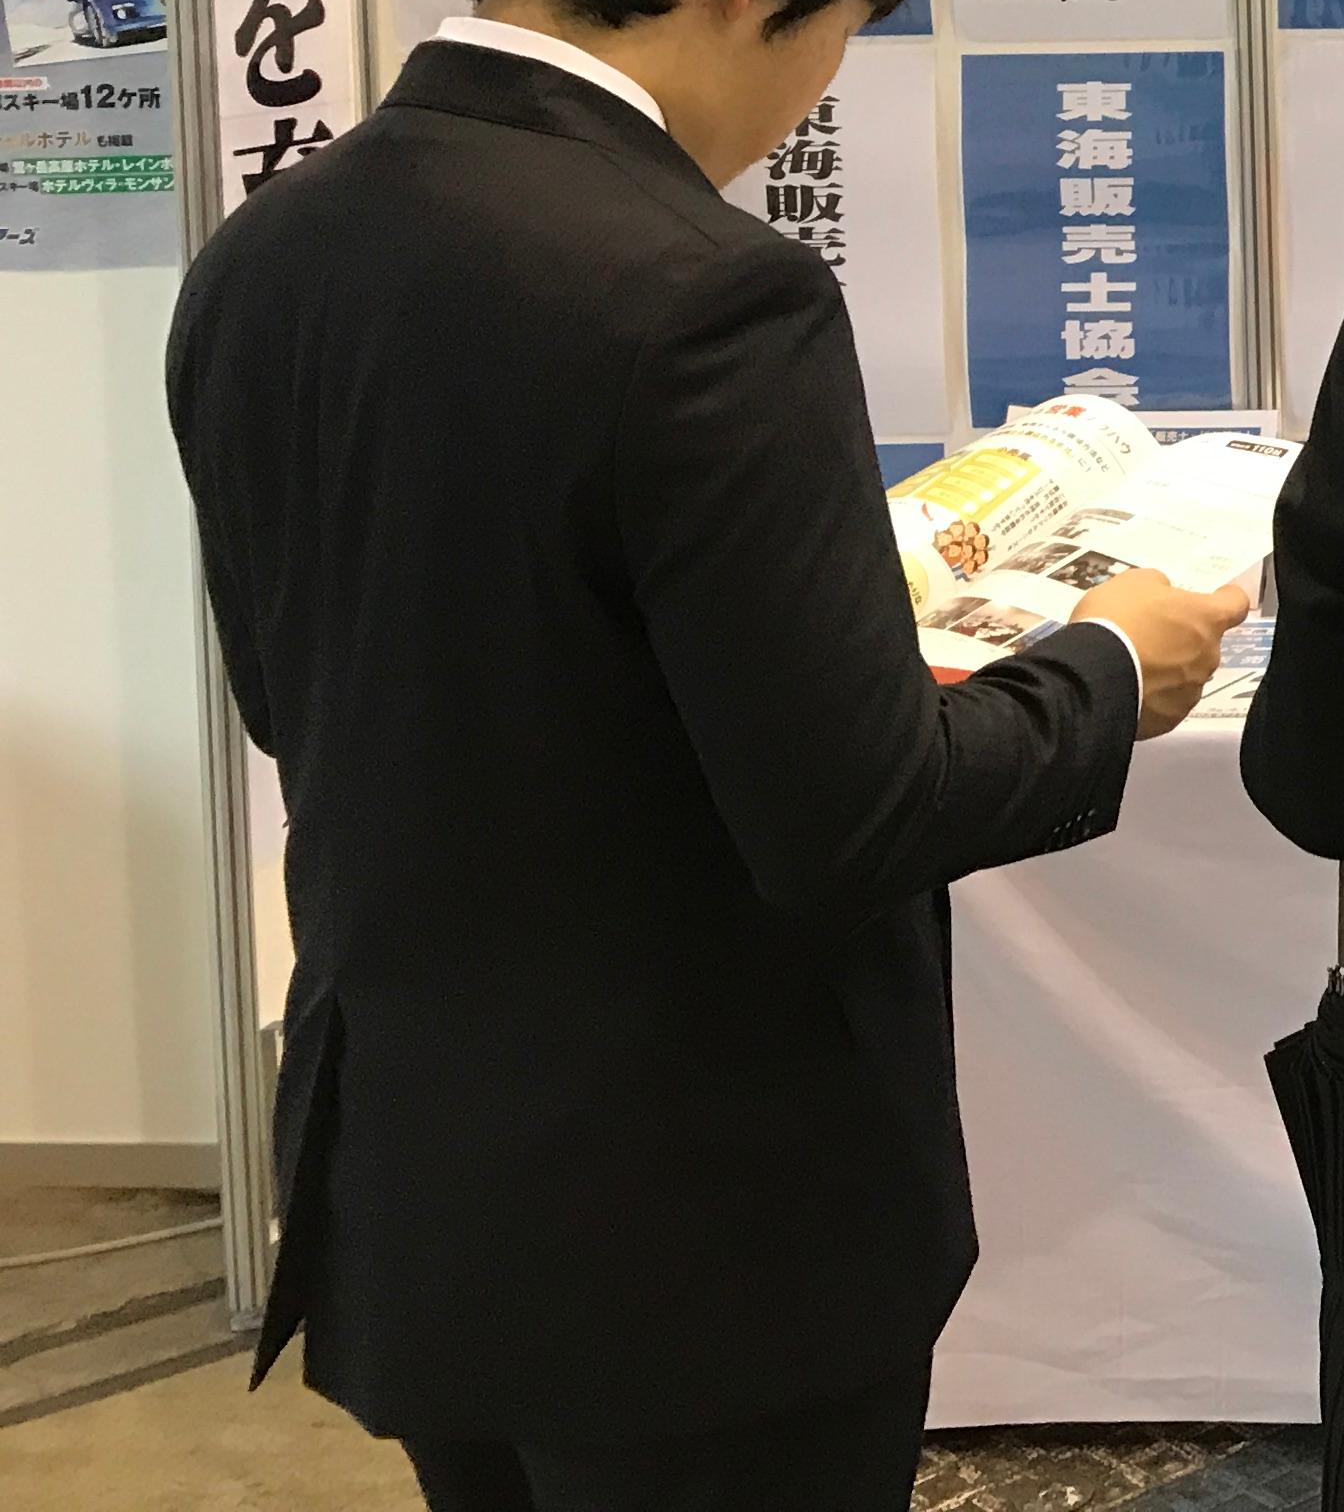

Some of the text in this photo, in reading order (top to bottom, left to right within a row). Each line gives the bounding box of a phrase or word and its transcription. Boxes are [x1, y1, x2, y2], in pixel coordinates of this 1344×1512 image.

[1056, 80, 1139, 406] 東海販売士協会
